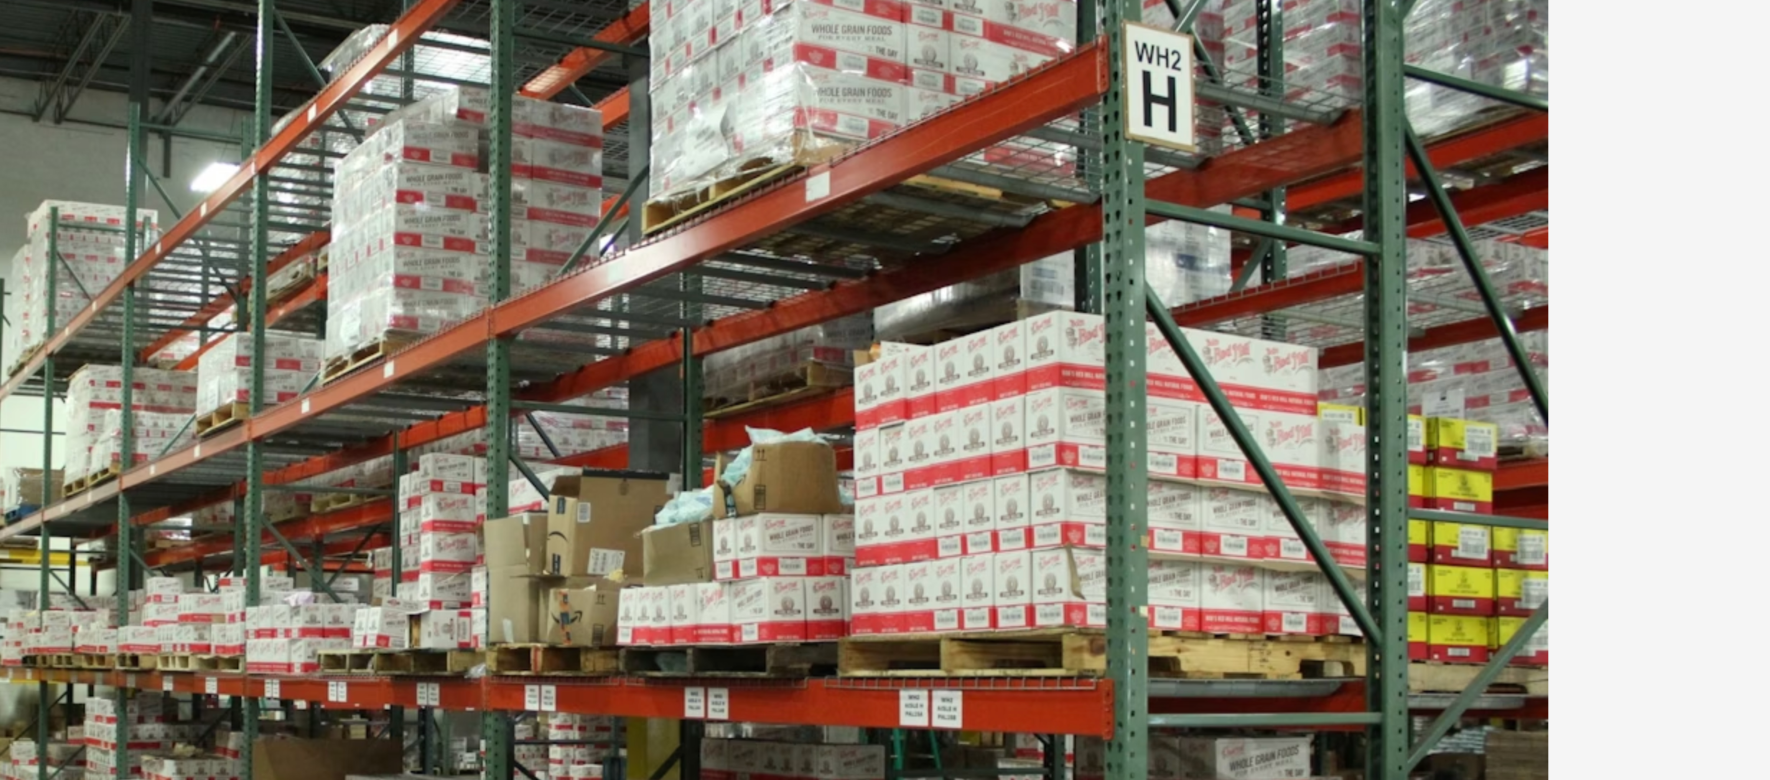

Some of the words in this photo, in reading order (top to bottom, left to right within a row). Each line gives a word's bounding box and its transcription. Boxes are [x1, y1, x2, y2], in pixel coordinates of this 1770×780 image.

[812, 24, 839, 34] WHOLE
[841, 24, 865, 35] GRAIN
[867, 25, 892, 35] FOODS
[876, 46, 886, 56] THE
[887, 48, 898, 58] DAY
[1135, 41, 1182, 71] WH2
[842, 87, 865, 97] GRAIN
[867, 88, 892, 98] FOODS
[1142, 69, 1177, 133] H
[876, 108, 886, 118] THE
[887, 111, 898, 120] DAY
[1078, 325, 1098, 346] Red
[1214, 344, 1231, 365] Red
[1232, 341, 1251, 362] Mill
[1273, 353, 1291, 373] Red
[1291, 350, 1309, 371] Mill
[1277, 426, 1294, 446] Red
[1229, 756, 1253, 771] WHOLE
[1255, 751, 1276, 765] GRAIN
[1277, 744, 1299, 759] FOODS
[1284, 768, 1294, 777] THE
[1295, 768, 1304, 777] DAY
